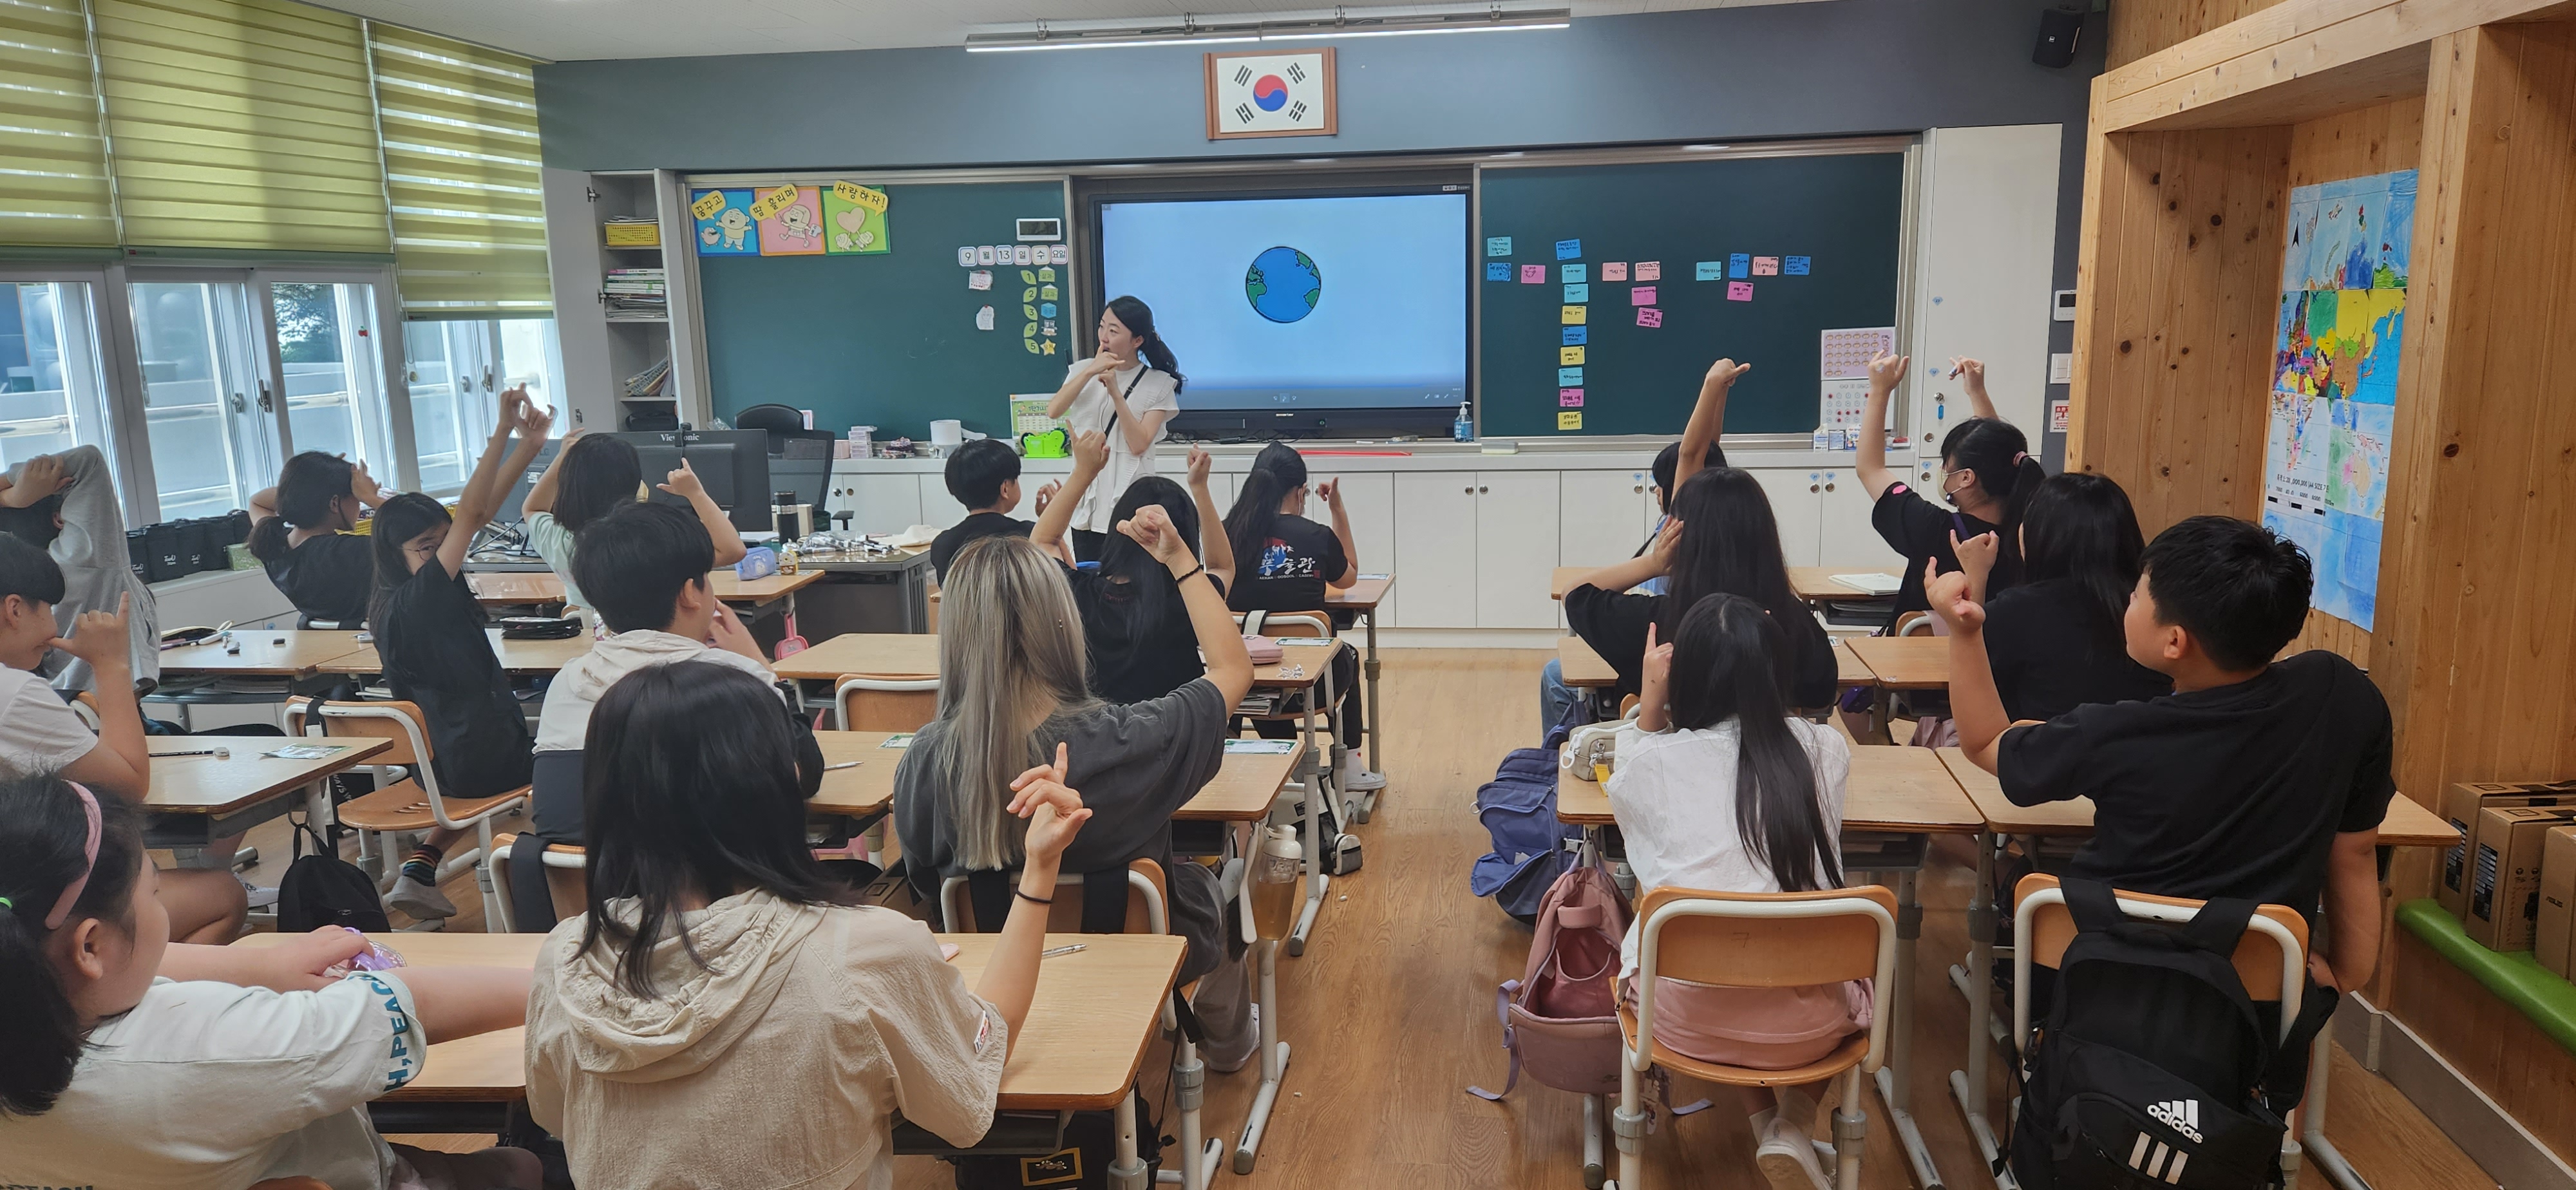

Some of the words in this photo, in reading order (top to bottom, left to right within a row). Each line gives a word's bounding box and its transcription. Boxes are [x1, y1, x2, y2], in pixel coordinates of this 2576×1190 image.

[752, 205, 764, 217] 땀
[768, 187, 795, 210] 흘리며
[837, 183, 886, 208] 사랑하자!
[695, 197, 723, 217] 꿈꾸고
[965, 252, 971, 261] 9
[983, 251, 990, 260] 월
[999, 250, 1010, 260] 13
[1018, 250, 1027, 260] 일
[1036, 250, 1045, 260] 수
[1052, 250, 1066, 258] 요일
[1028, 290, 1034, 298] 2
[660, 433, 699, 442] Vieonic
[2146, 1103, 2204, 1144] adidas
